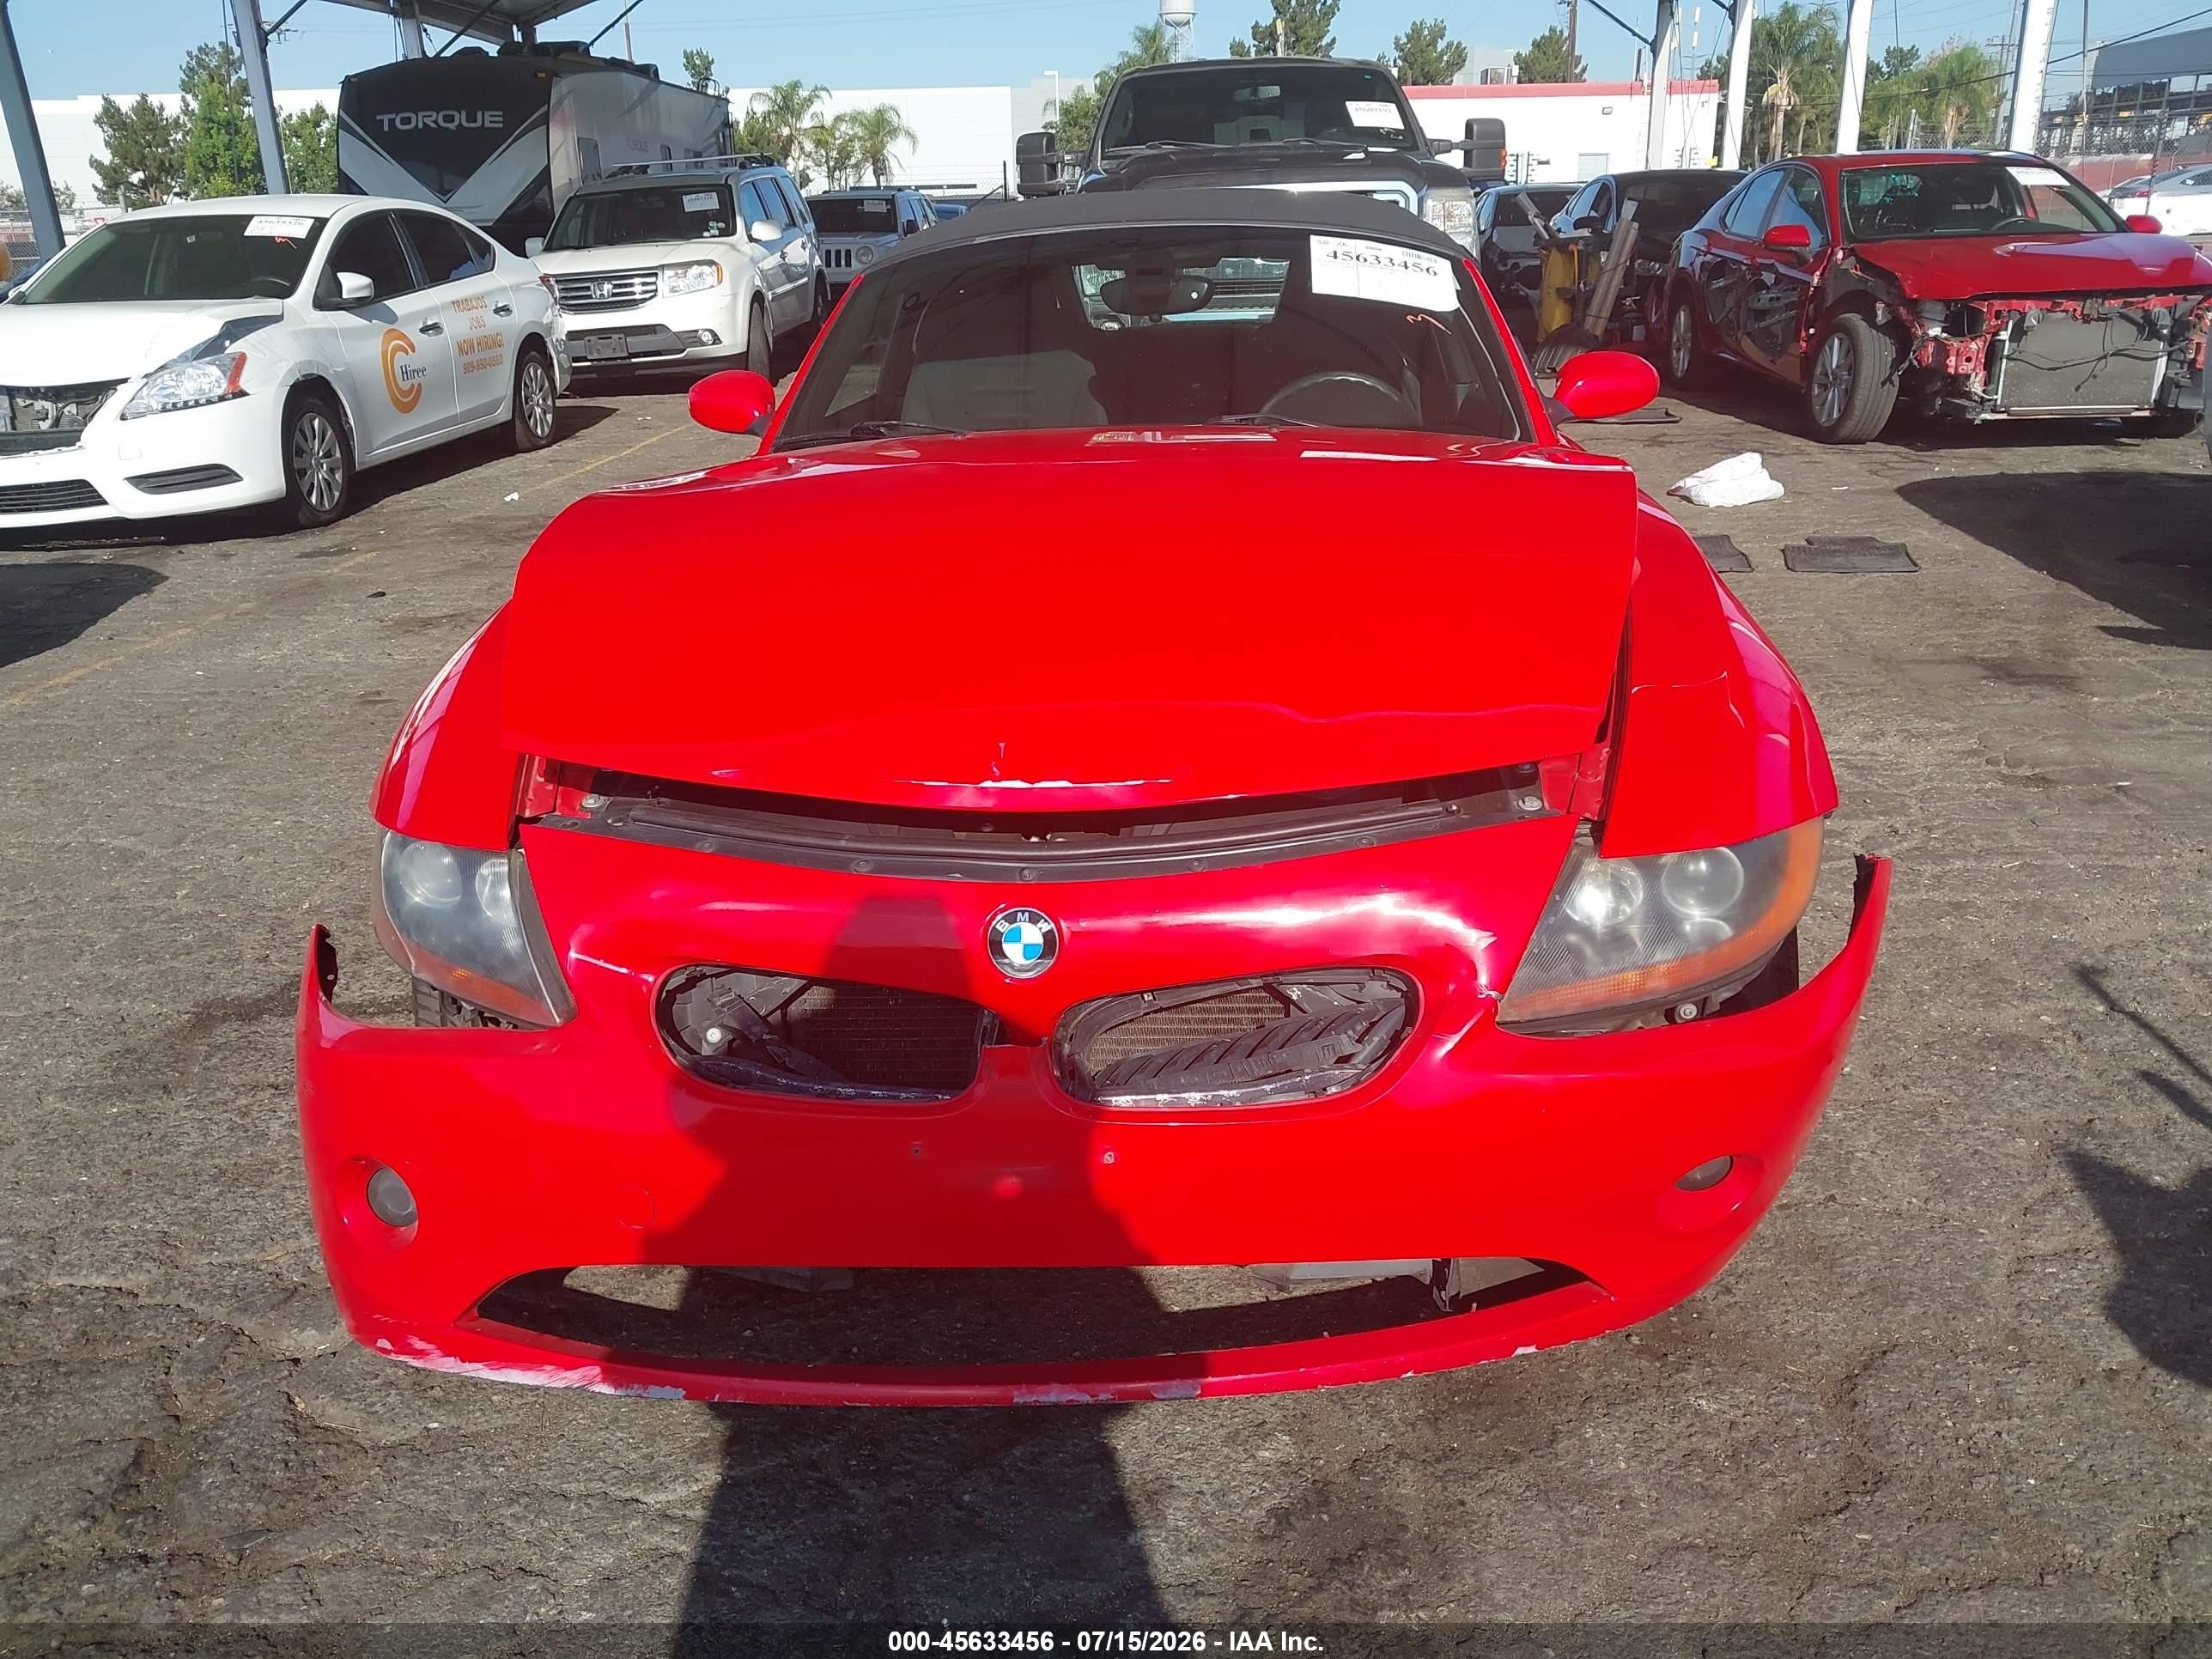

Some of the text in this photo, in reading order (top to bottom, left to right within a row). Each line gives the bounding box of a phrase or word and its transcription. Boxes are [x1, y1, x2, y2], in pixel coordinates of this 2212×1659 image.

[376, 110, 503, 131] TORQUE
[1326, 250, 1438, 276] 45633456
[452, 295, 488, 314] TRABAJOS
[468, 315, 486, 331] JOBS
[457, 331, 505, 357] NOW HIRING!
[399, 364, 427, 382] Hiree
[995, 911, 1053, 933] BMW
